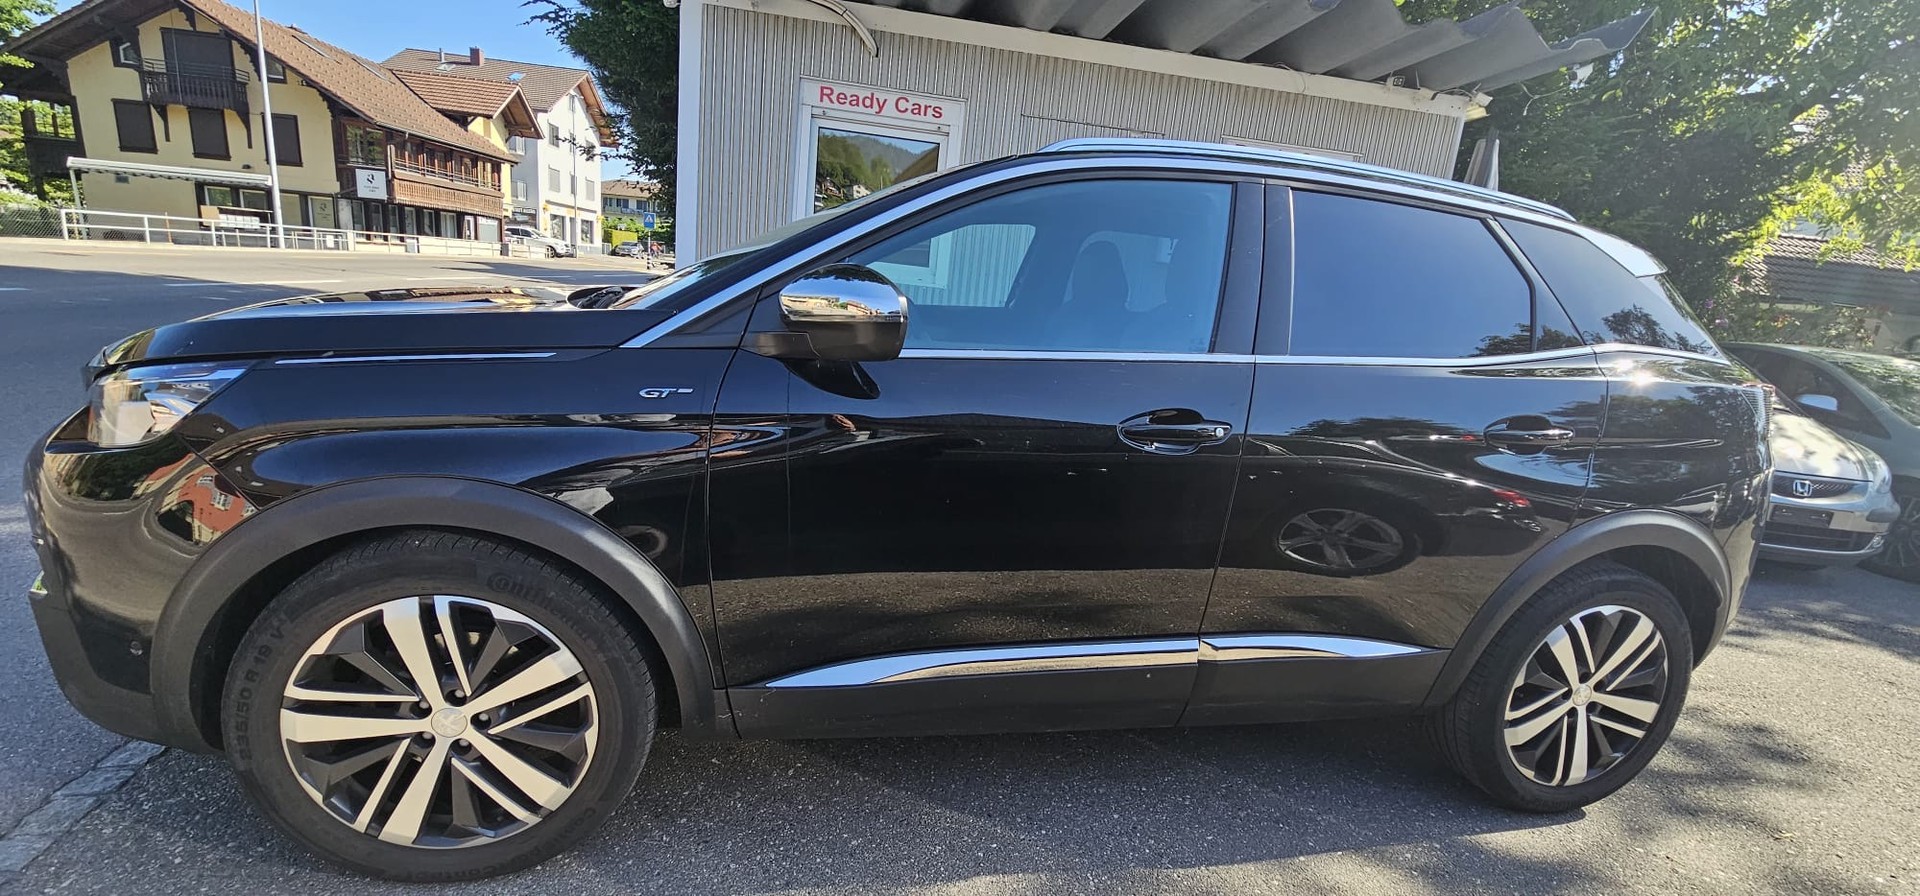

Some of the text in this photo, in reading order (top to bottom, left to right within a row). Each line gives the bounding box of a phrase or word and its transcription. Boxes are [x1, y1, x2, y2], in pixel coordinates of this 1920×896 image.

[819, 85, 944, 119] Ready Cars
[639, 387, 677, 398] GT
